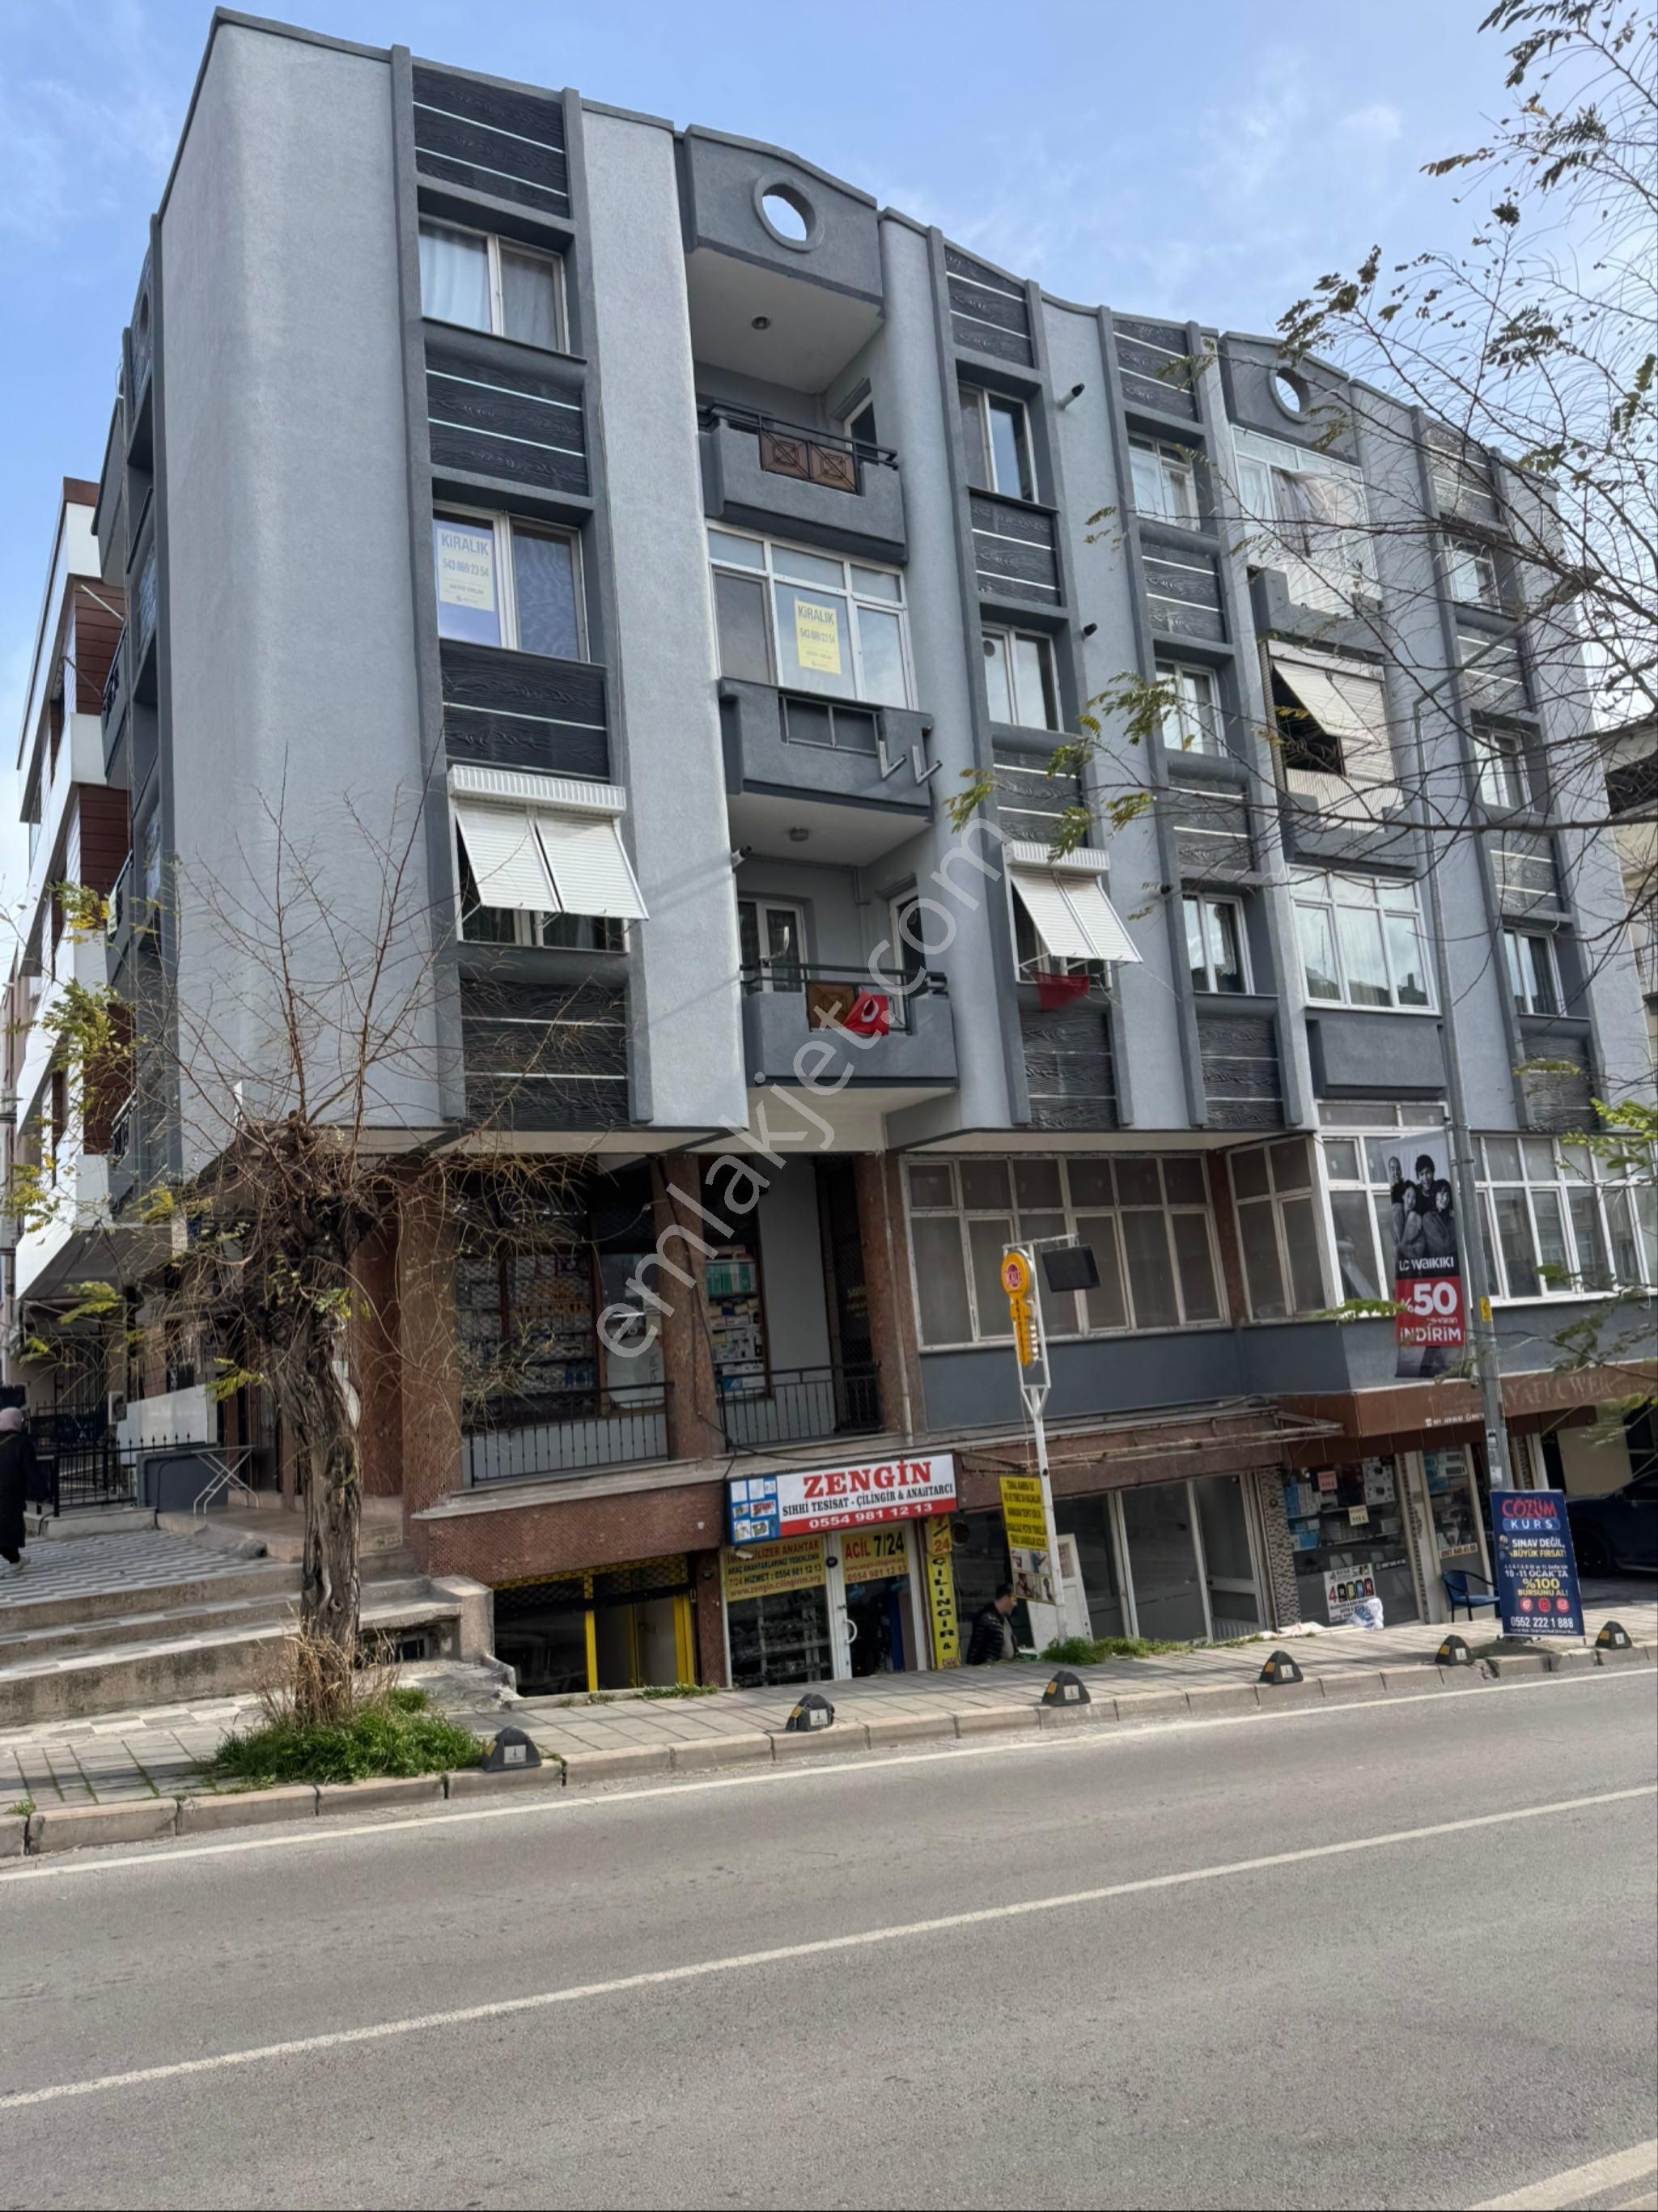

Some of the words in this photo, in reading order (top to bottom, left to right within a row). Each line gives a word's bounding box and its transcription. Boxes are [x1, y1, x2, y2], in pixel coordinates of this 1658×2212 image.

[803, 1458, 932, 1500] ZENGİN
[782, 1497, 809, 1516] SIHHİ
[811, 1495, 849, 1512] TESİSAT
[856, 1489, 896, 1509] ÇİLİNGİR
[898, 1490, 904, 1500] &
[906, 1483, 953, 1499] ANAHTARCI
[809, 1514, 850, 1529] 0554
[855, 1510, 884, 1522] 981
[891, 1505, 909, 1516] 12
[914, 1503, 933, 1512] 13
[1510, 1519, 1553, 1529] KURS
[782, 1540, 819, 1555] ANAHTAR
[846, 1537, 871, 1560] ACİL
[873, 1531, 905, 1558] 7/24
[1512, 1538, 1537, 1548] SINAV
[1512, 1548, 1539, 1558] BÜYÜK
[846, 1571, 867, 1582] 0554
[869, 1569, 884, 1579] 981
[1529, 1570, 1569, 1578] OCAK'TA
[1522, 1578, 1560, 1590] %100
[1518, 1589, 1554, 1597] BURSUNU
[1510, 1616, 1531, 1628] 0552
[1533, 1617, 1549, 1628] 222
[1557, 1617, 1574, 1629] 888
